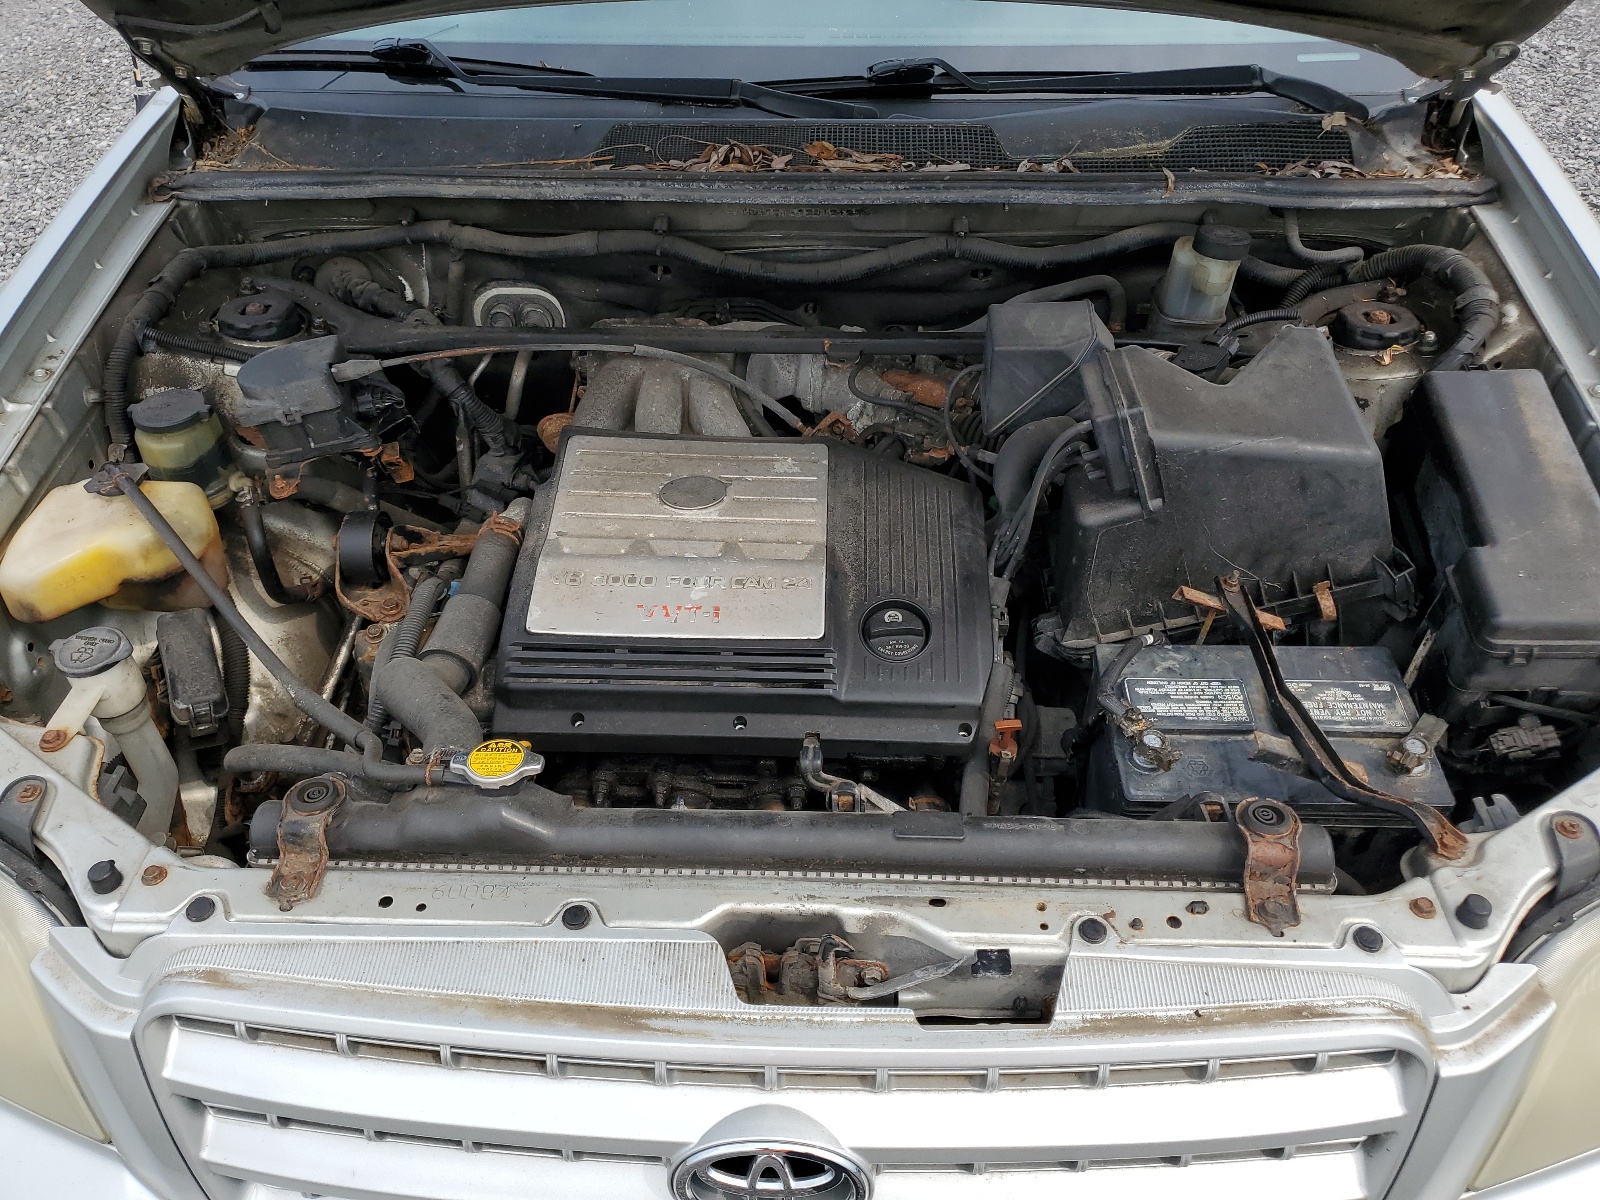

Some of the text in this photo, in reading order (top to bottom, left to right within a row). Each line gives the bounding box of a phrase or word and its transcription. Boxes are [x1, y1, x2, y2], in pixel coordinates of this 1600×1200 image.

[590, 573, 657, 588] 3000
[730, 576, 777, 590] CAM
[1327, 701, 1385, 710] MAINTENANCE
